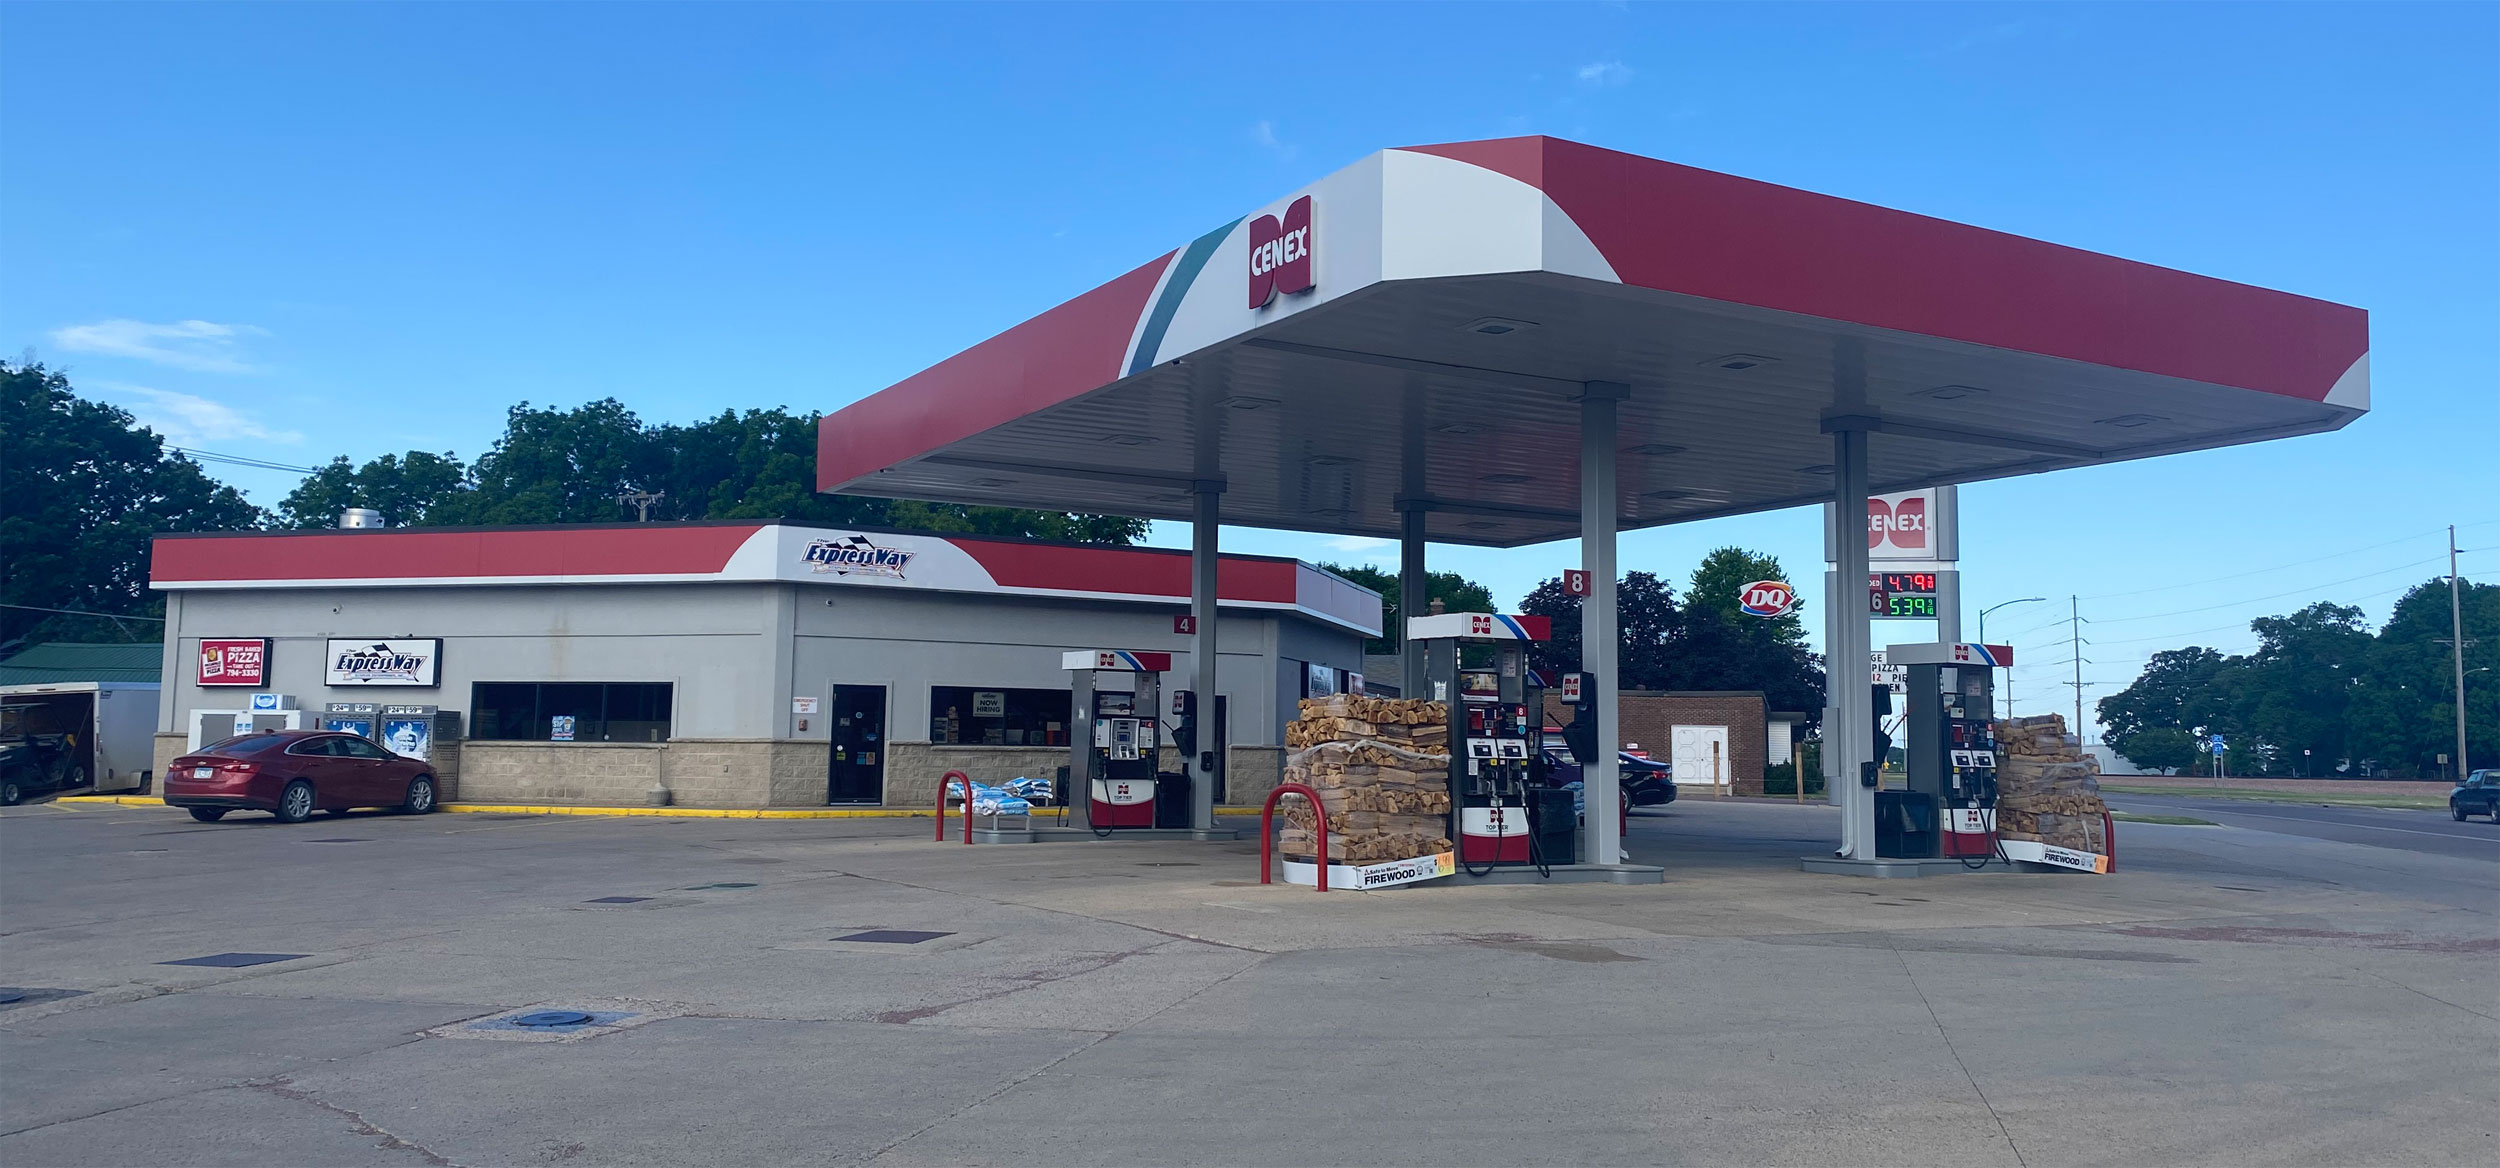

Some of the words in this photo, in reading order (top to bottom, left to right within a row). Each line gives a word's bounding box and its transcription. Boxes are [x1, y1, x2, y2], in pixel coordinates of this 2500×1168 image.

[1251, 225, 1307, 277] CENEX
[1868, 513, 1924, 532] ENEX
[805, 544, 914, 567] ExpressWay
[1571, 573, 1583, 592] 8
[1889, 575, 1925, 591] 4.79
[1749, 589, 1786, 608] DQ
[1180, 618, 1190, 632] 4
[1473, 621, 1492, 629] CENEX
[336, 654, 424, 673] ExpressWay
[1871, 663, 1899, 672] PIZZA
[226, 668, 260, 677] 794-3330
[1872, 673, 1882, 682] 12
[1518, 707, 1524, 715] 8
[2044, 853, 2080, 866] FIREWOOD
[1364, 868, 1416, 886] FIREWOOD
